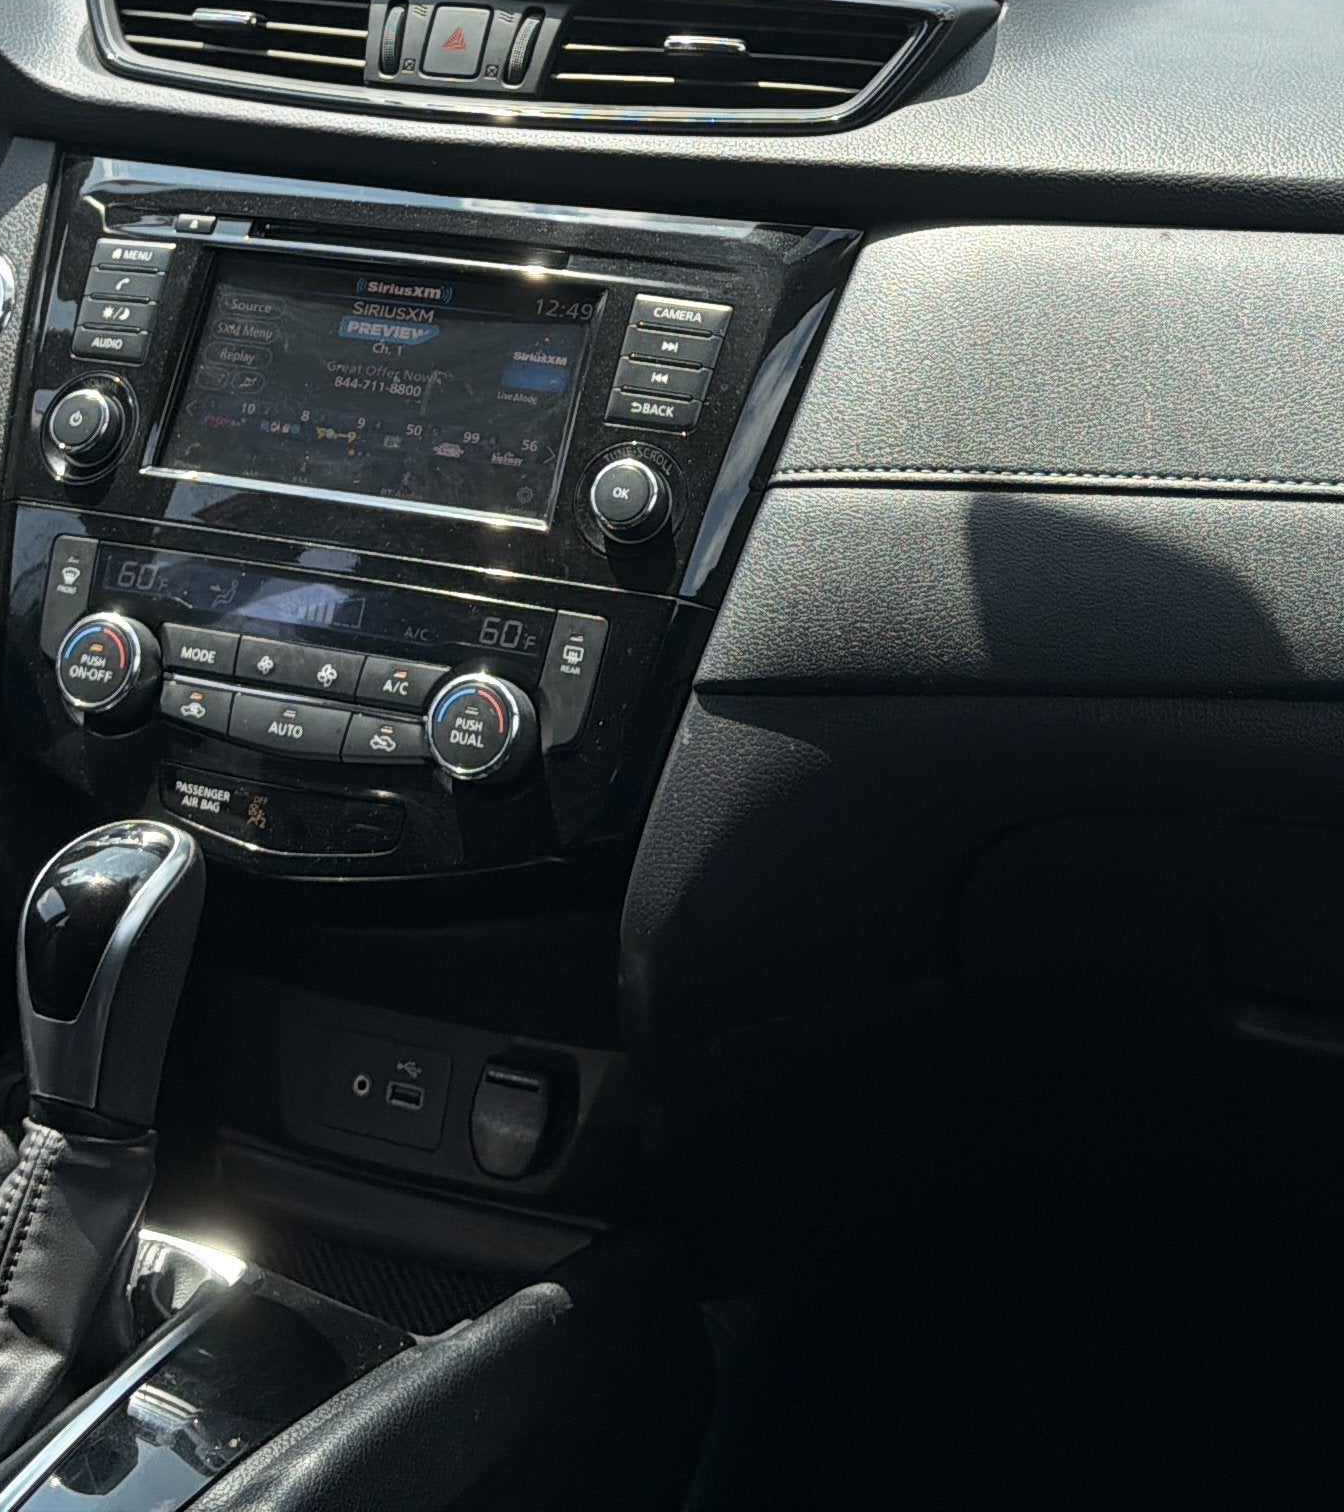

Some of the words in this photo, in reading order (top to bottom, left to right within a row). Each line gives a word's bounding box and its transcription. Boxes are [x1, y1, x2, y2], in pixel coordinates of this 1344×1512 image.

[123, 250, 153, 262] MENU
[231, 299, 273, 314] Source
[535, 298, 594, 321] 12:49
[653, 307, 702, 323] CAMERA
[241, 325, 274, 341] Menu
[347, 321, 431, 340] PREVIEW
[91, 338, 123, 350] AUDIO
[220, 349, 256, 364] Replay
[326, 360, 362, 375] Great
[334, 375, 422, 397] 844-711-8800
[241, 402, 256, 415] 10
[300, 410, 310, 422] 8
[642, 403, 675, 418] BACK
[356, 417, 366, 430] 9
[406, 423, 423, 437] 50
[463, 431, 480, 444] 99
[521, 439, 538, 452] 56
[612, 486, 631, 500] OK
[117, 561, 158, 590] 60
[404, 626, 429, 640] A/C
[479, 616, 523, 648] 60
[80, 653, 106, 668] PUSH
[180, 645, 217, 664] MODE
[560, 663, 581, 675] REAR
[382, 679, 410, 696] A/C
[267, 720, 304, 739] AUTO
[455, 716, 484, 730] PUSH
[449, 729, 484, 748] DUAL
[175, 780, 231, 803] PASSENGER
[181, 794, 199, 808] AIR
[200, 797, 221, 813] BAG
